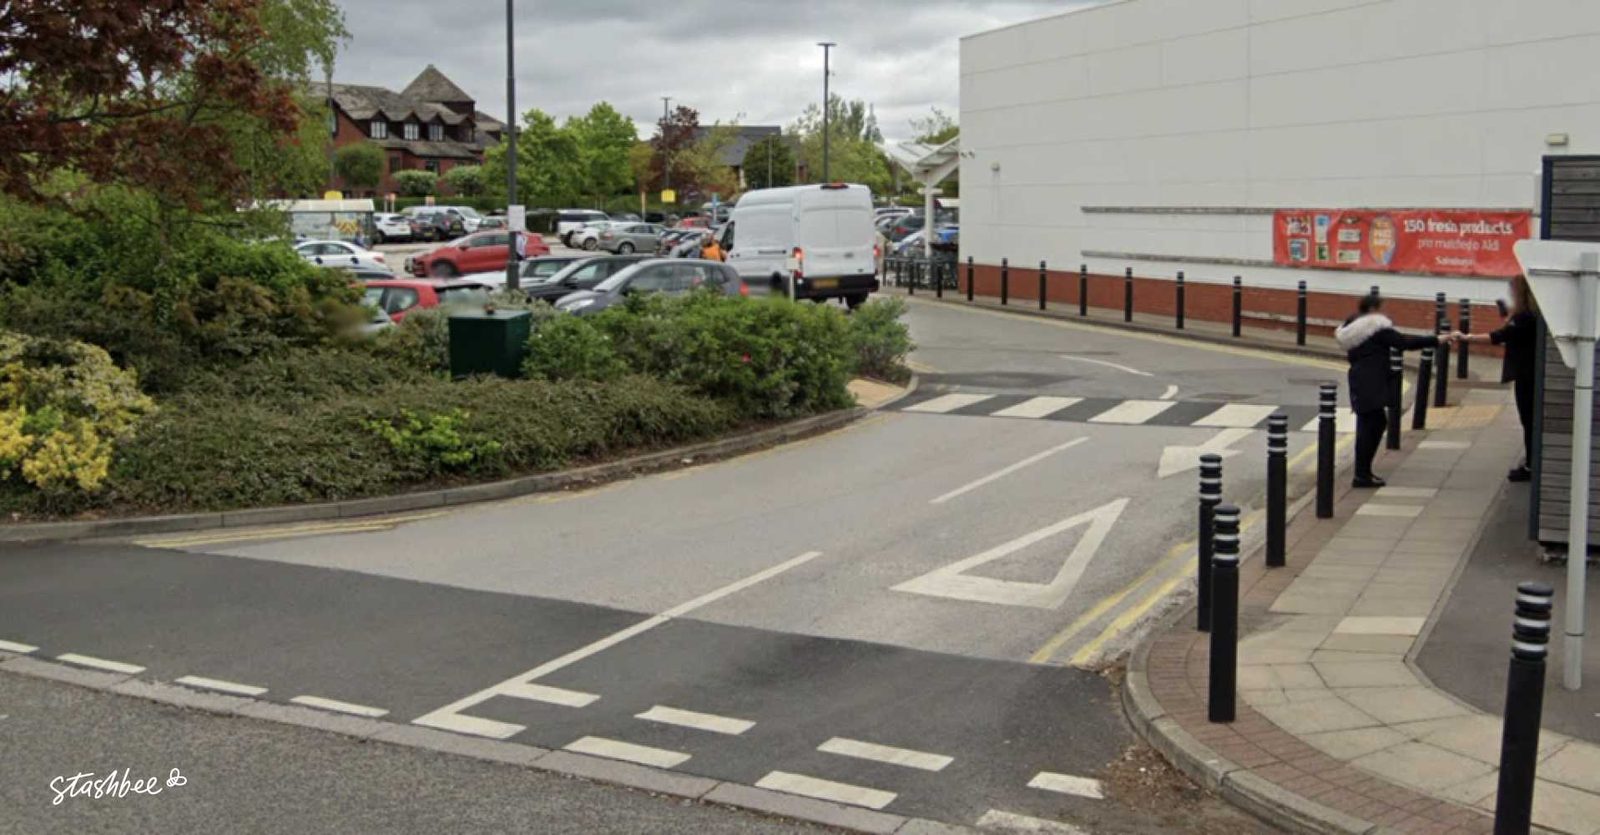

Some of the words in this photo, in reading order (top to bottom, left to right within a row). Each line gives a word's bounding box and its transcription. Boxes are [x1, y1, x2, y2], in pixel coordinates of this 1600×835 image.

[1404, 219, 1426, 233] 150
[1427, 218, 1458, 233] fresh
[1459, 219, 1513, 237] products
